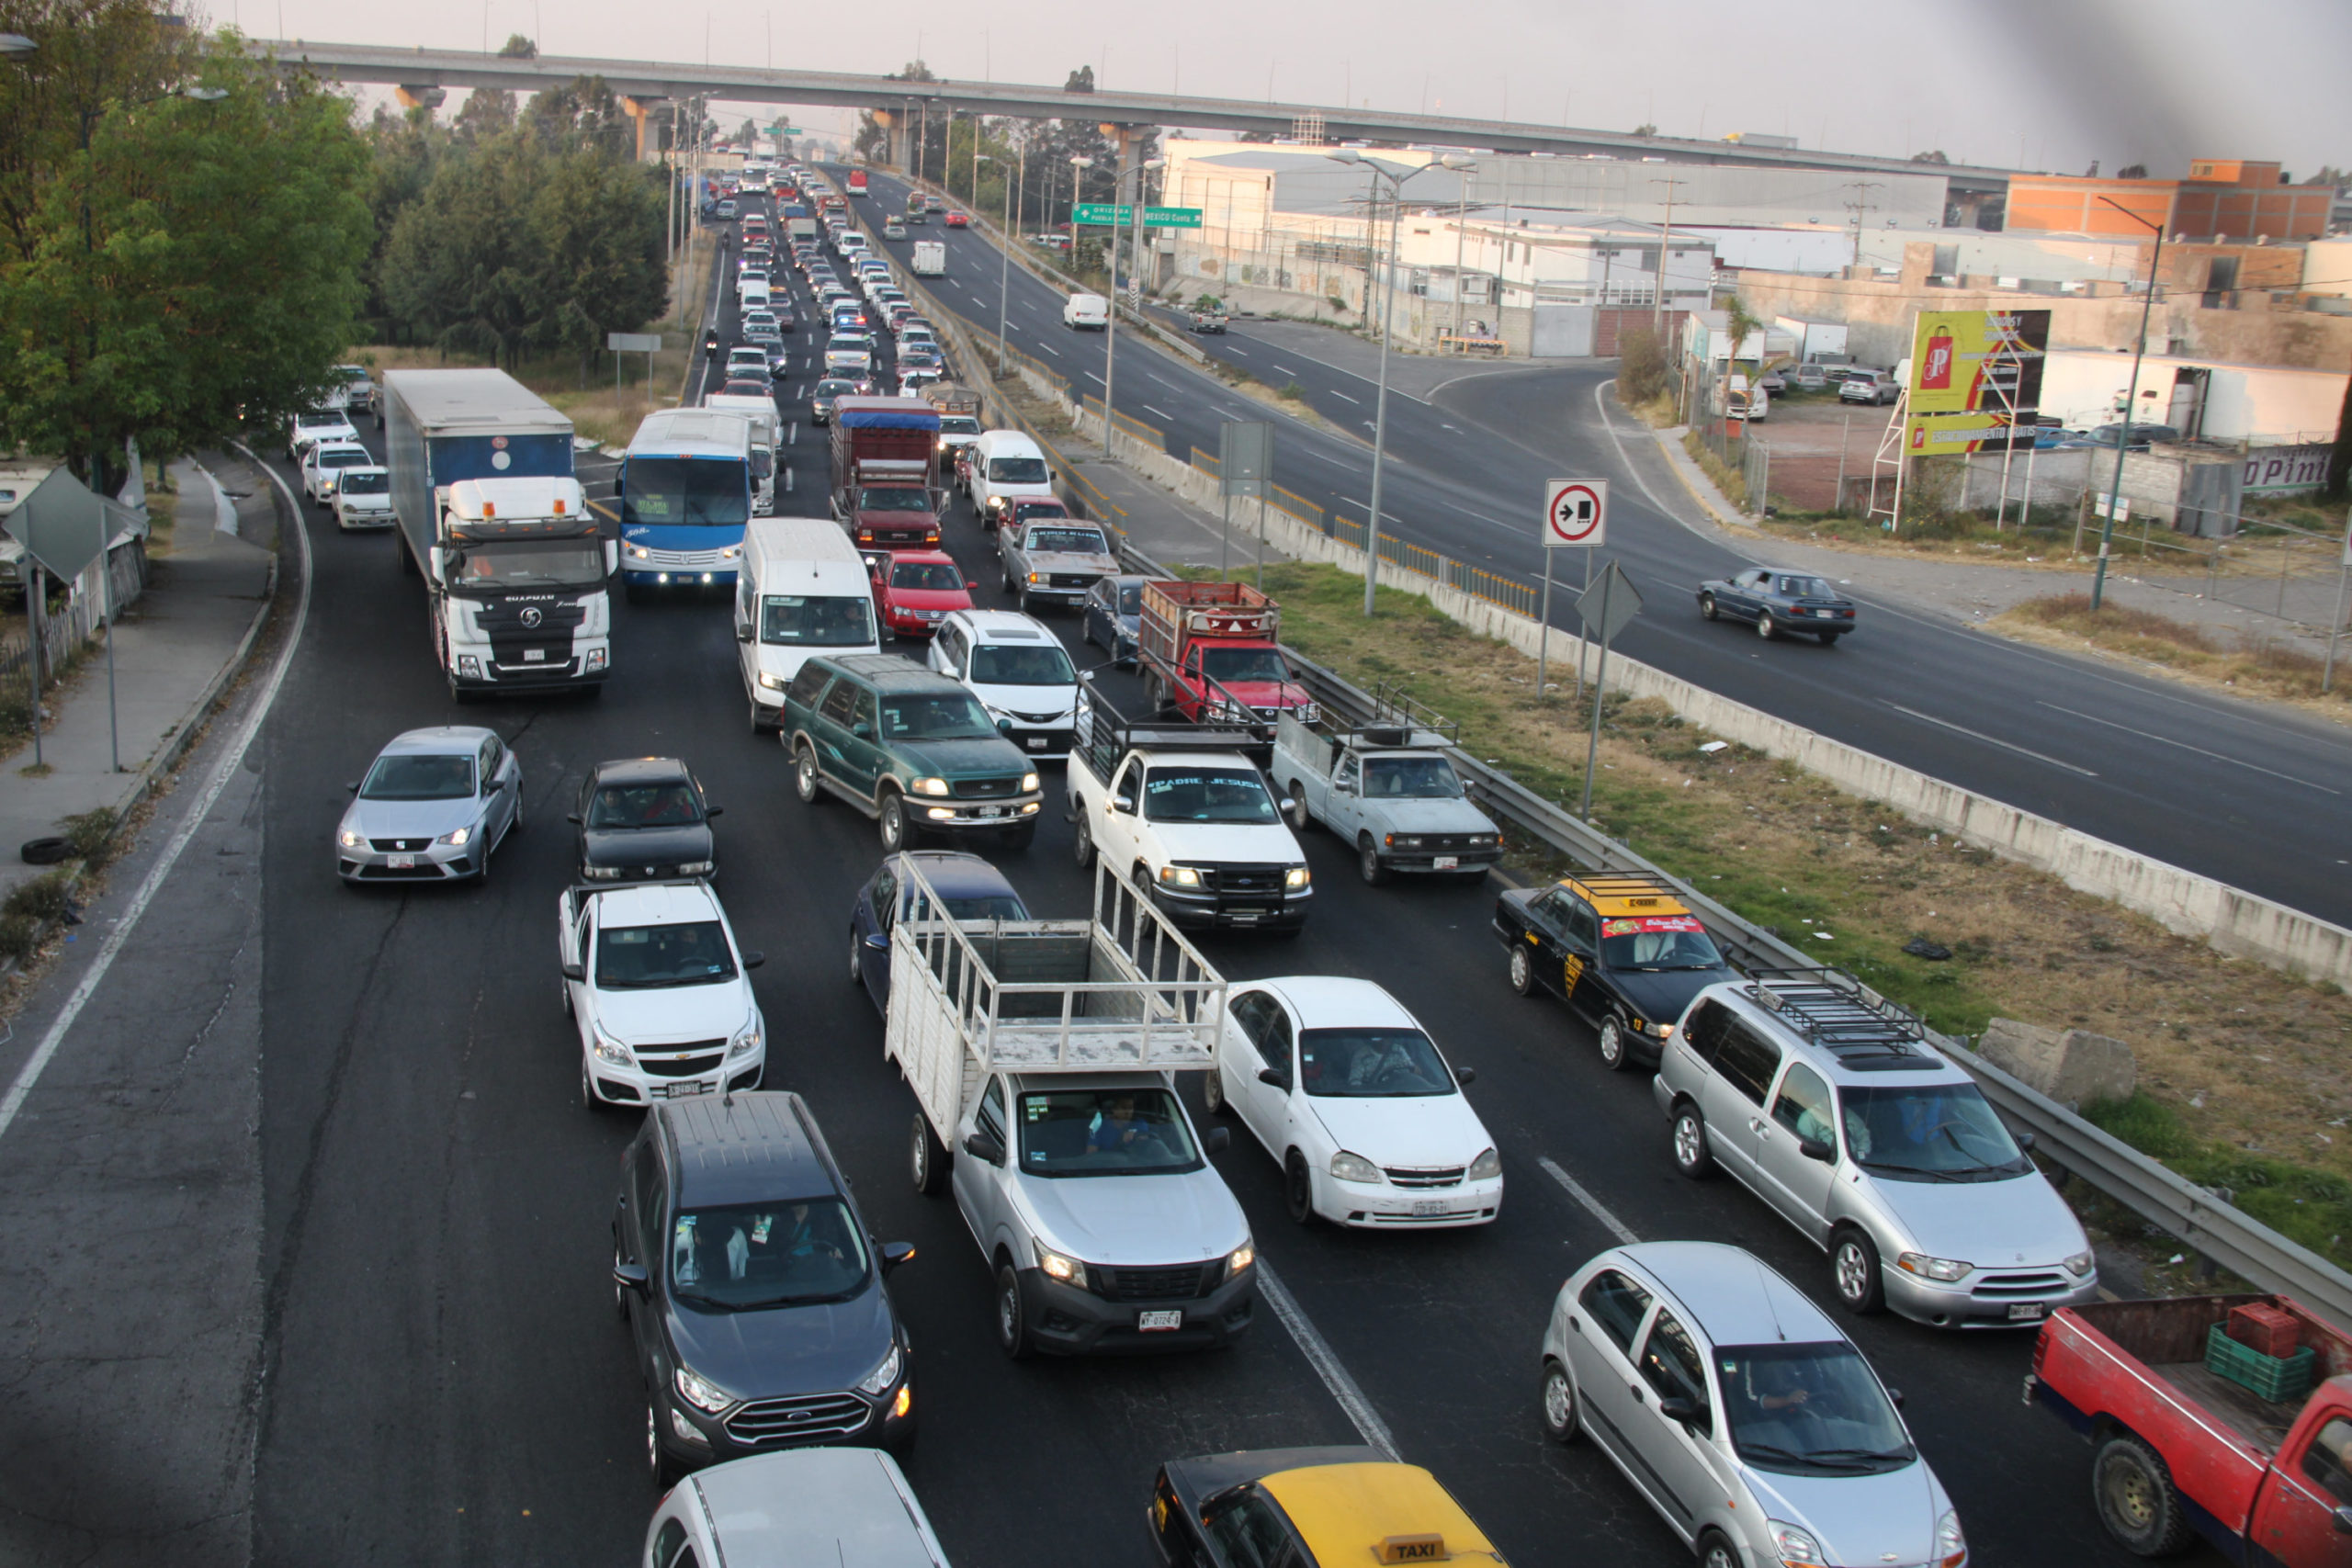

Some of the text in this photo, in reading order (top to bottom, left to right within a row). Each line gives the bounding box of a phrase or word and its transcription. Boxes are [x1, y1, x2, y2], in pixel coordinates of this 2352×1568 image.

[1932, 427, 2006, 443] ESTACIONAMIENTO
[1155, 778, 1254, 788] PADRE JESUS
[1634, 1018, 1644, 1032] 13
[1396, 1544, 1435, 1559] TAXI
